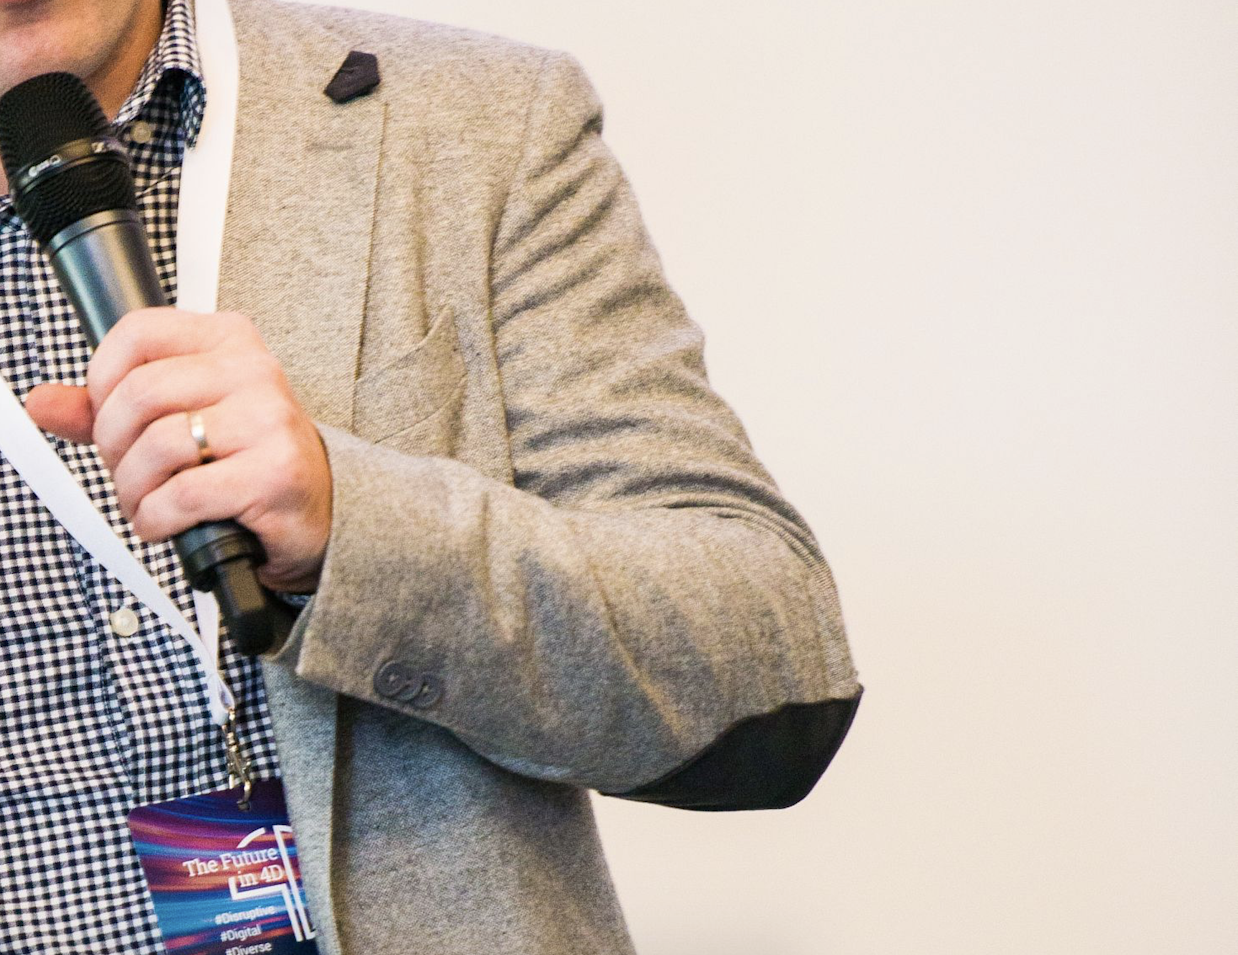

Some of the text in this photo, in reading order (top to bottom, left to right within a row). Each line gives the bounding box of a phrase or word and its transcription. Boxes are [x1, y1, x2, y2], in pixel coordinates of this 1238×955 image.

[182, 847, 279, 877] The Future
[237, 864, 284, 888] in 4D
[215, 904, 277, 925] #Disruptive
[220, 924, 262, 943] #Digital
[225, 941, 273, 955] #Diverse
